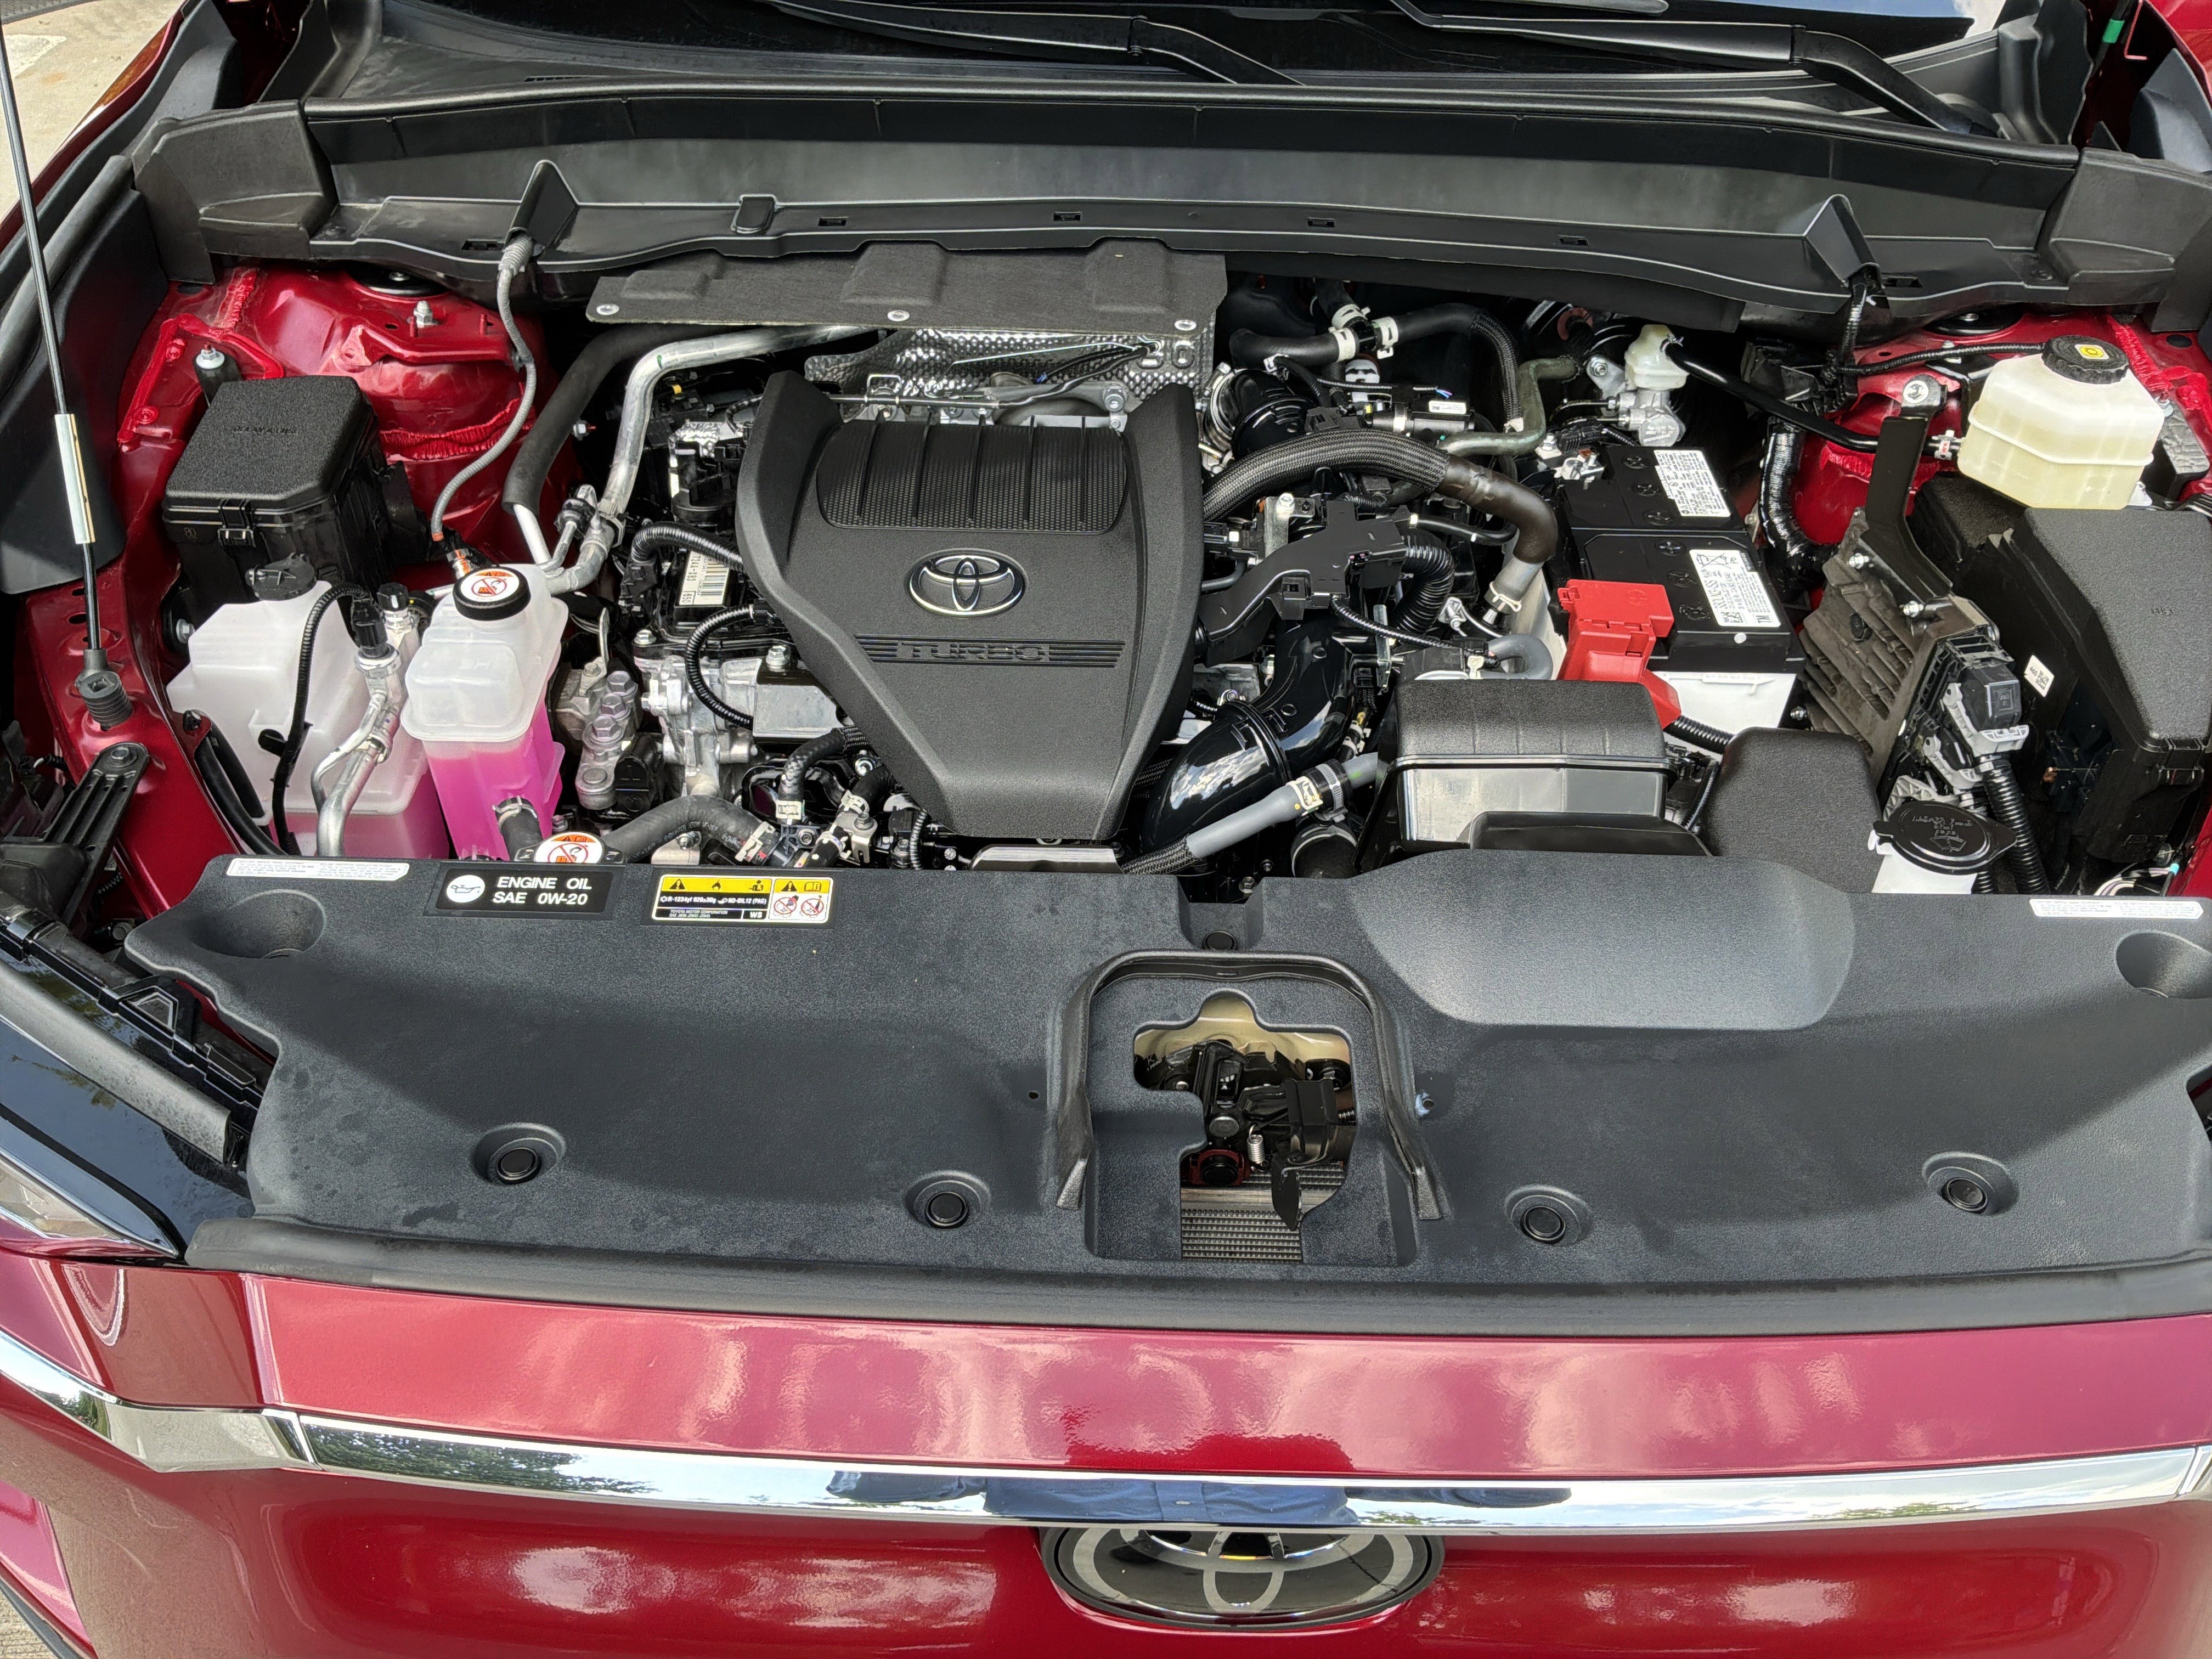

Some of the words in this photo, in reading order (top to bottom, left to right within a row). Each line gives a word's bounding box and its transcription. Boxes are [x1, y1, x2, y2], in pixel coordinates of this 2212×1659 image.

[901, 641, 1046, 661] TURBO
[496, 876, 558, 890] ENGINE
[566, 878, 592, 890] OIL
[492, 891, 528, 904] SAE
[537, 893, 589, 905] 0W-20
